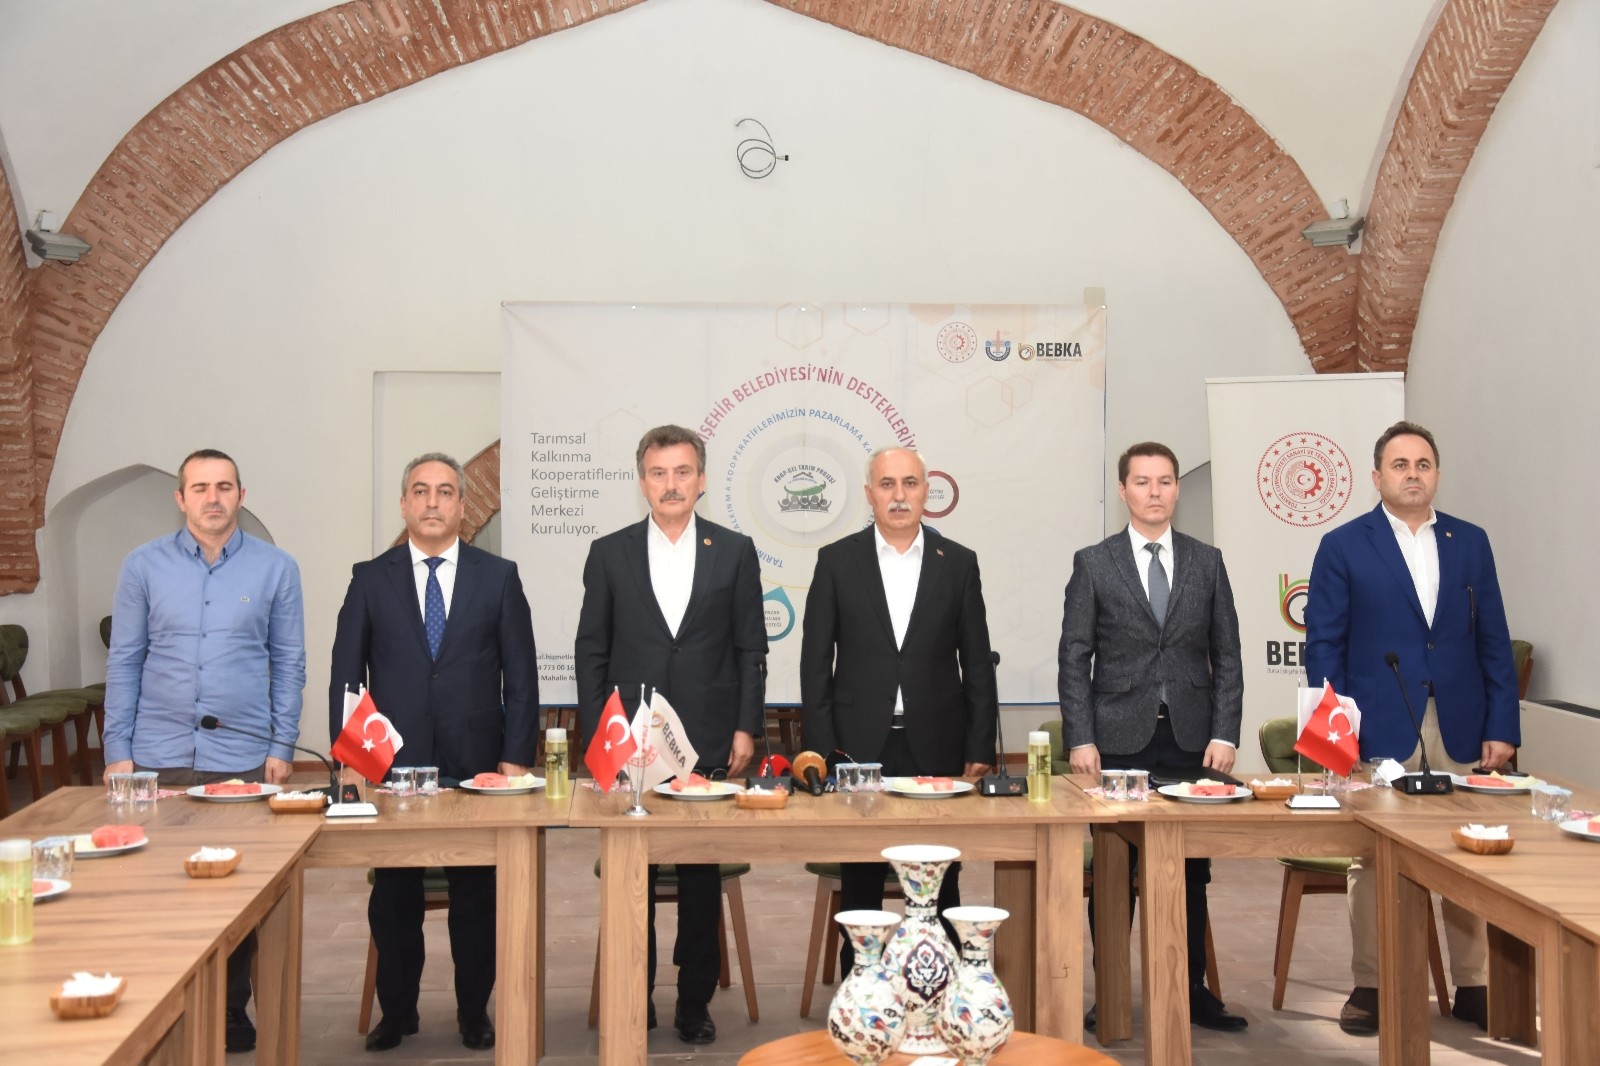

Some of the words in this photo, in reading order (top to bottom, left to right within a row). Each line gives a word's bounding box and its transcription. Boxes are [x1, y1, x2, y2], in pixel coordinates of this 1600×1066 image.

[1036, 342, 1082, 357] BEBKA
[696, 397, 736, 445] İŞEHİR
[732, 363, 844, 402] BELEDİYESİ'NİN
[846, 376, 918, 452] DESTEKLERİY
[809, 408, 863, 442] PAZARLAMA
[530, 432, 586, 445] Tarımsal
[726, 407, 806, 482] KOOPERATİFLERİMİZİN
[531, 450, 591, 462] Kalkınma
[531, 468, 634, 482] Kooperatiflerini
[531, 486, 599, 501] Geliştirme
[531, 504, 584, 516] Merkezi
[725, 486, 743, 534] ALKINMA
[531, 522, 599, 537] Kuruluyor.
[662, 721, 686, 768] BEBKA
